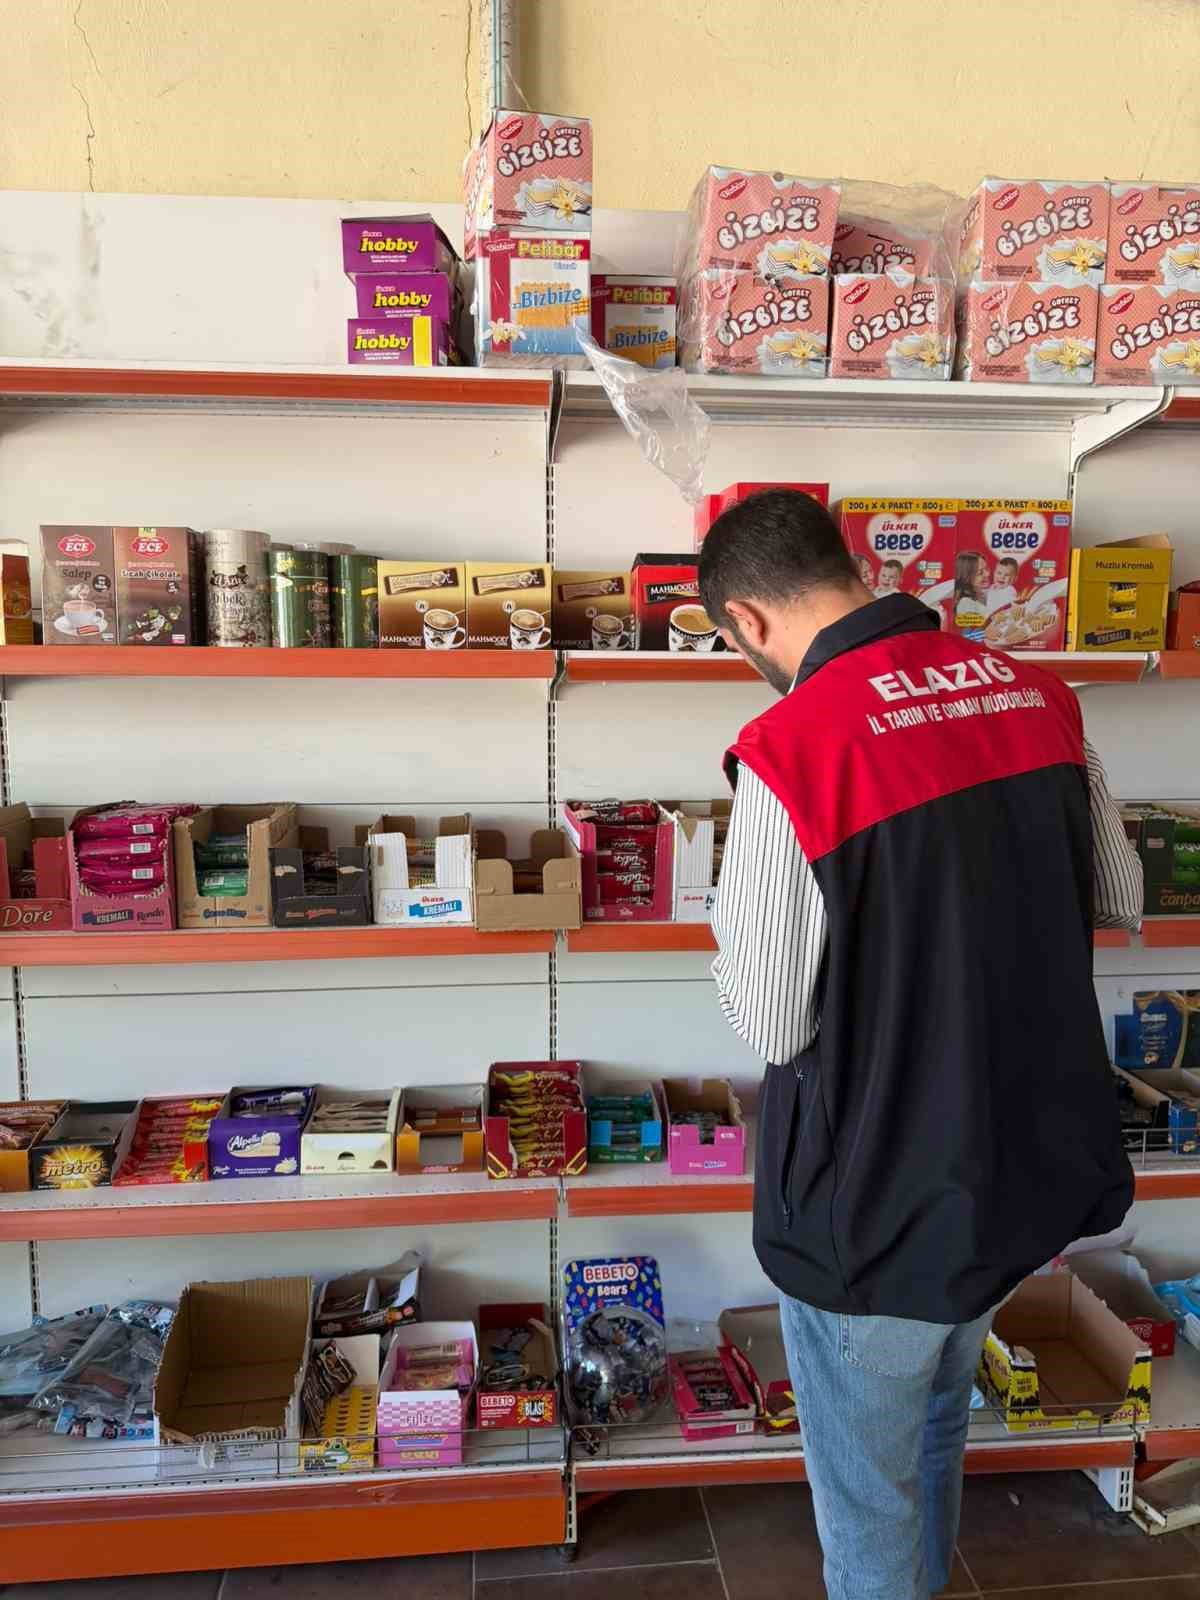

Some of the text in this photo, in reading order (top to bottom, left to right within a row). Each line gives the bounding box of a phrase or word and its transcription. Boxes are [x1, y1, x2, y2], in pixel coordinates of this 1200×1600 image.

[360, 237, 419, 253] hobby
[374, 291, 432, 307] hobby
[521, 287, 582, 308] Bizbize
[354, 334, 412, 350] hobby
[616, 330, 669, 348] Bizbize
[888, 502, 913, 510] PAKET
[1004, 501, 1029, 509] PAKET
[882, 520, 918, 531] ÜLKER
[998, 519, 1033, 530] ÜLKER
[65, 542, 89, 552] ECE
[137, 542, 163, 552] ECE
[62, 568, 92, 580] Salep
[650, 583, 695, 595] MAHMOOD
[381, 636, 422, 644] MAHMOOD
[469, 635, 509, 643] MAHMOOD
[867, 652, 1016, 702] ELAZIĞ
[866, 713, 886, 736] İL
[883, 706, 927, 730] TARIM
[925, 703, 942, 722] VE
[943, 697, 981, 719] ORMAN
[1160, 893, 1200, 909] canpa
[3, 905, 53, 927] Dore
[46, 1160, 101, 1177] metro
[584, 1264, 638, 1282] BEBETO
[481, 1396, 515, 1407] BEBETO
[525, 1401, 545, 1416] BLAST
